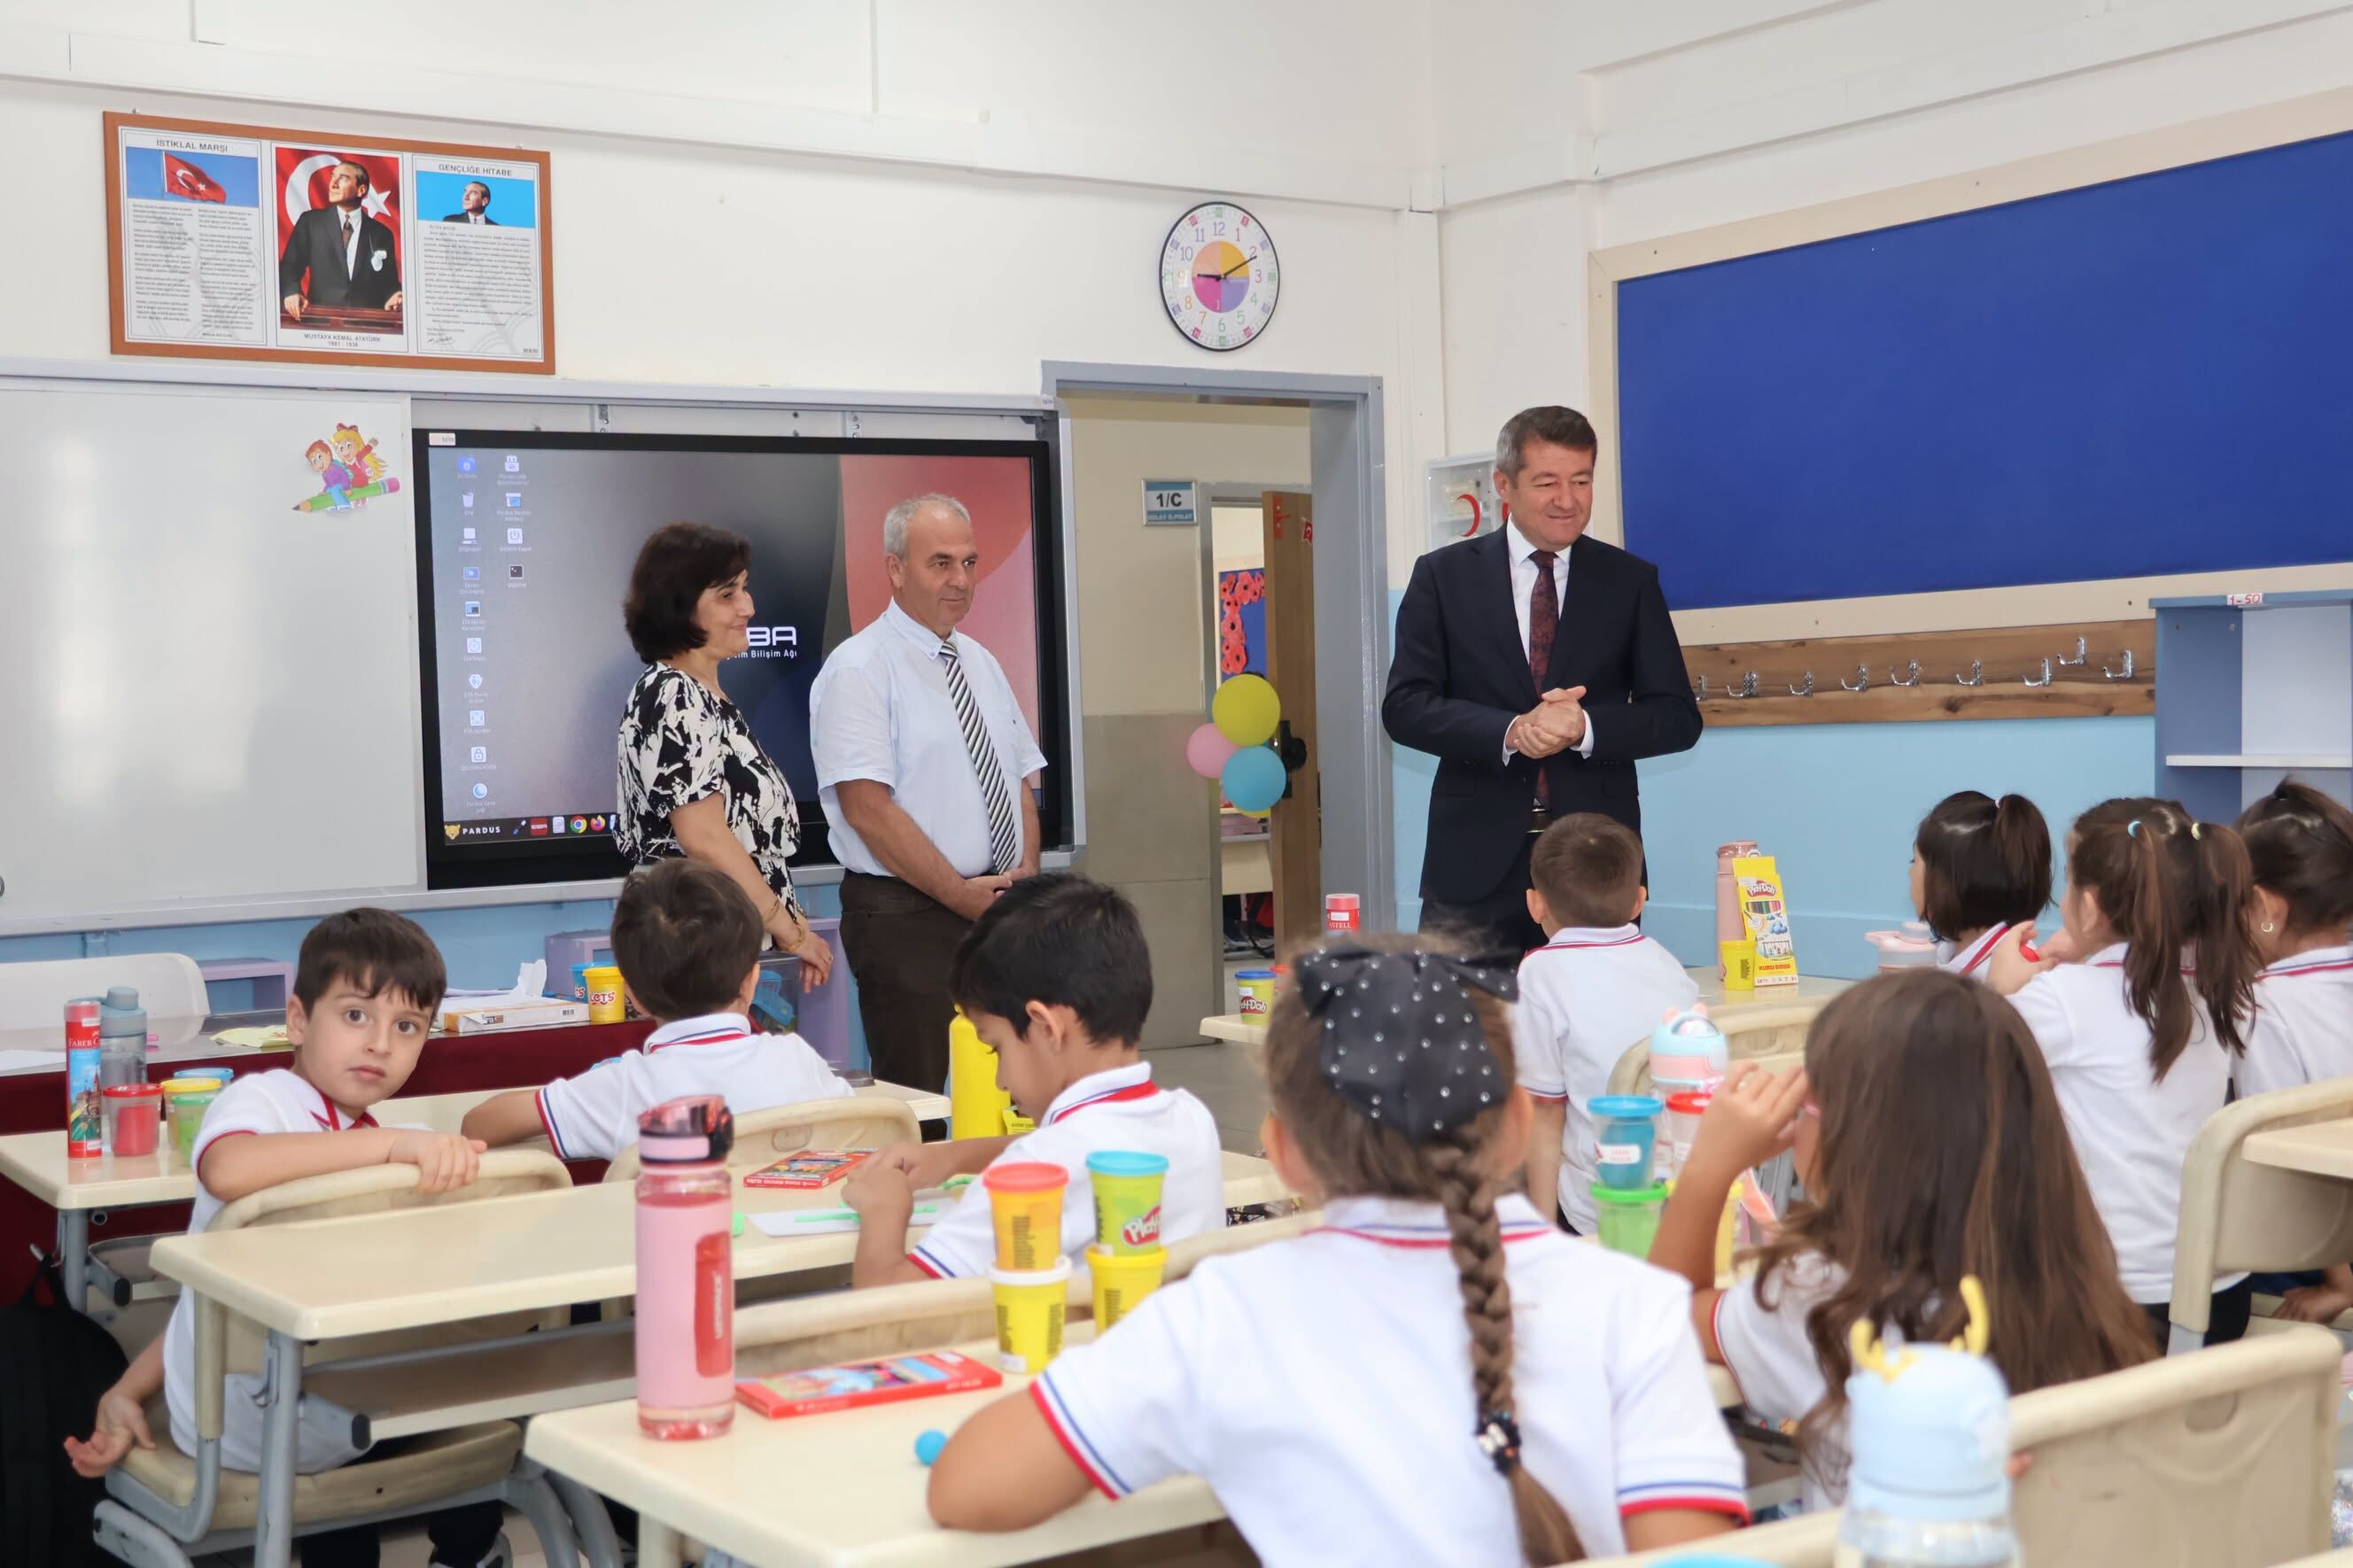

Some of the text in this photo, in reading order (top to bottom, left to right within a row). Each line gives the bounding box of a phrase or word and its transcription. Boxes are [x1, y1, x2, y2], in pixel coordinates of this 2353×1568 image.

[199, 143, 228, 152] MARŞI
[1195, 228, 1205, 242] 11
[1213, 221, 1225, 236] 12
[1235, 227, 1240, 241] 1
[1180, 246, 1193, 261] 10
[1250, 246, 1257, 260] 2
[1255, 269, 1262, 283] 3
[1184, 295, 1192, 309] 8
[1250, 292, 1257, 306] 4
[1199, 311, 1208, 325] 7
[1238, 310, 1245, 324] 5
[1218, 318, 1226, 332] 6
[1156, 493, 1182, 508] 1/C
[746, 626, 797, 647] BA
[750, 649, 780, 659] Bilişim
[784, 649, 797, 659] Ağı
[462, 827, 501, 835] PARDUS
